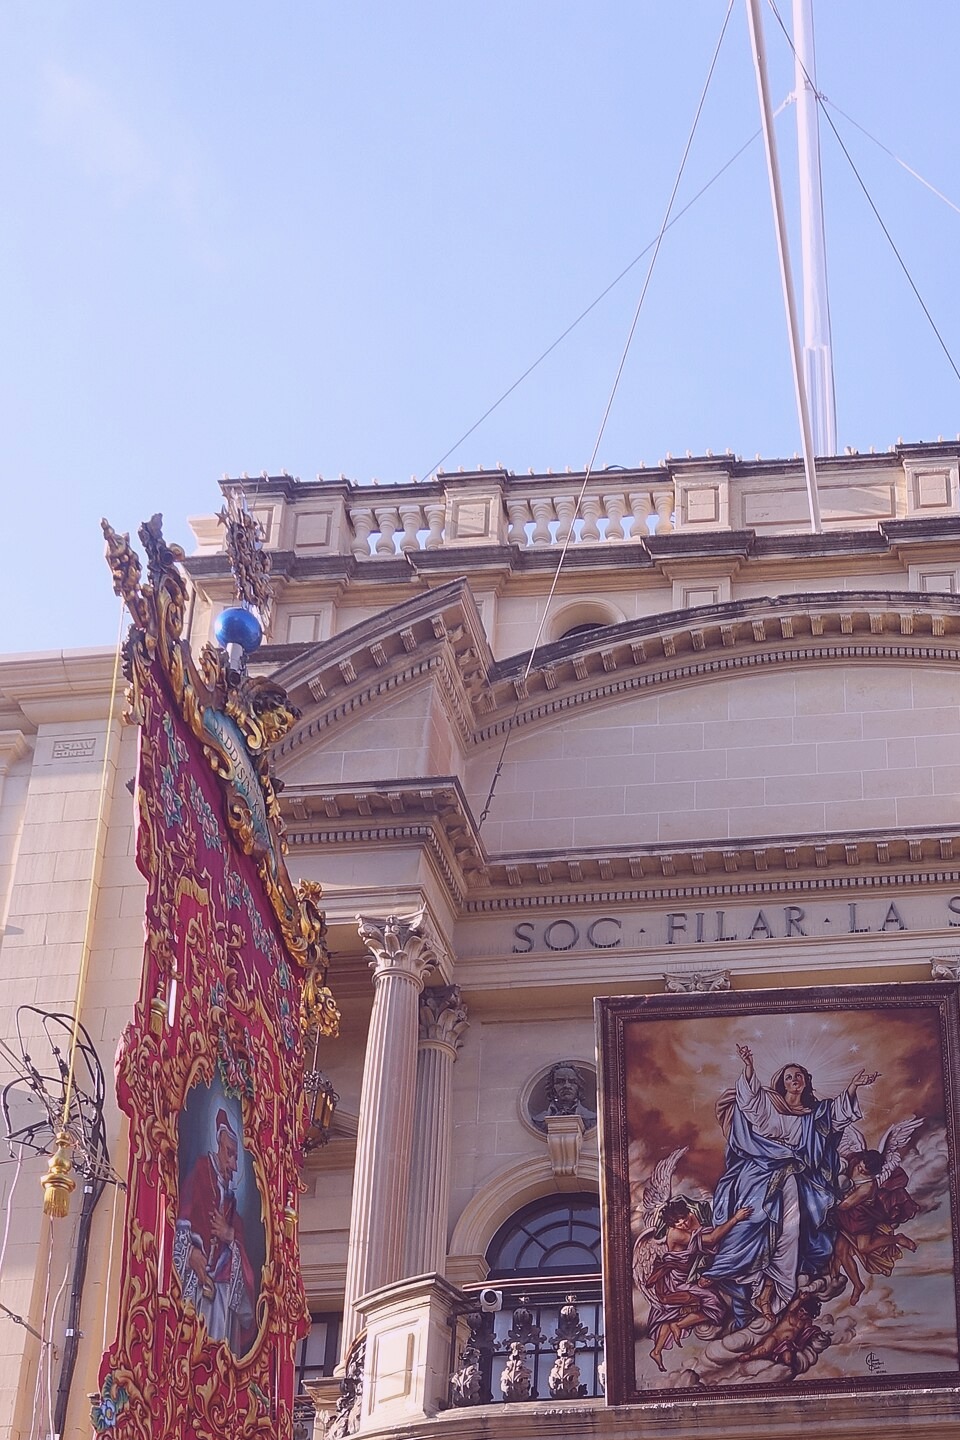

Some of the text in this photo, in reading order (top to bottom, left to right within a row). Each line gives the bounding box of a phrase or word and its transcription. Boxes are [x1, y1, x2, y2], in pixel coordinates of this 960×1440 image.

[513, 917, 622, 953] SOC
[666, 906, 808, 945] FILAR
[848, 901, 908, 933] LA
